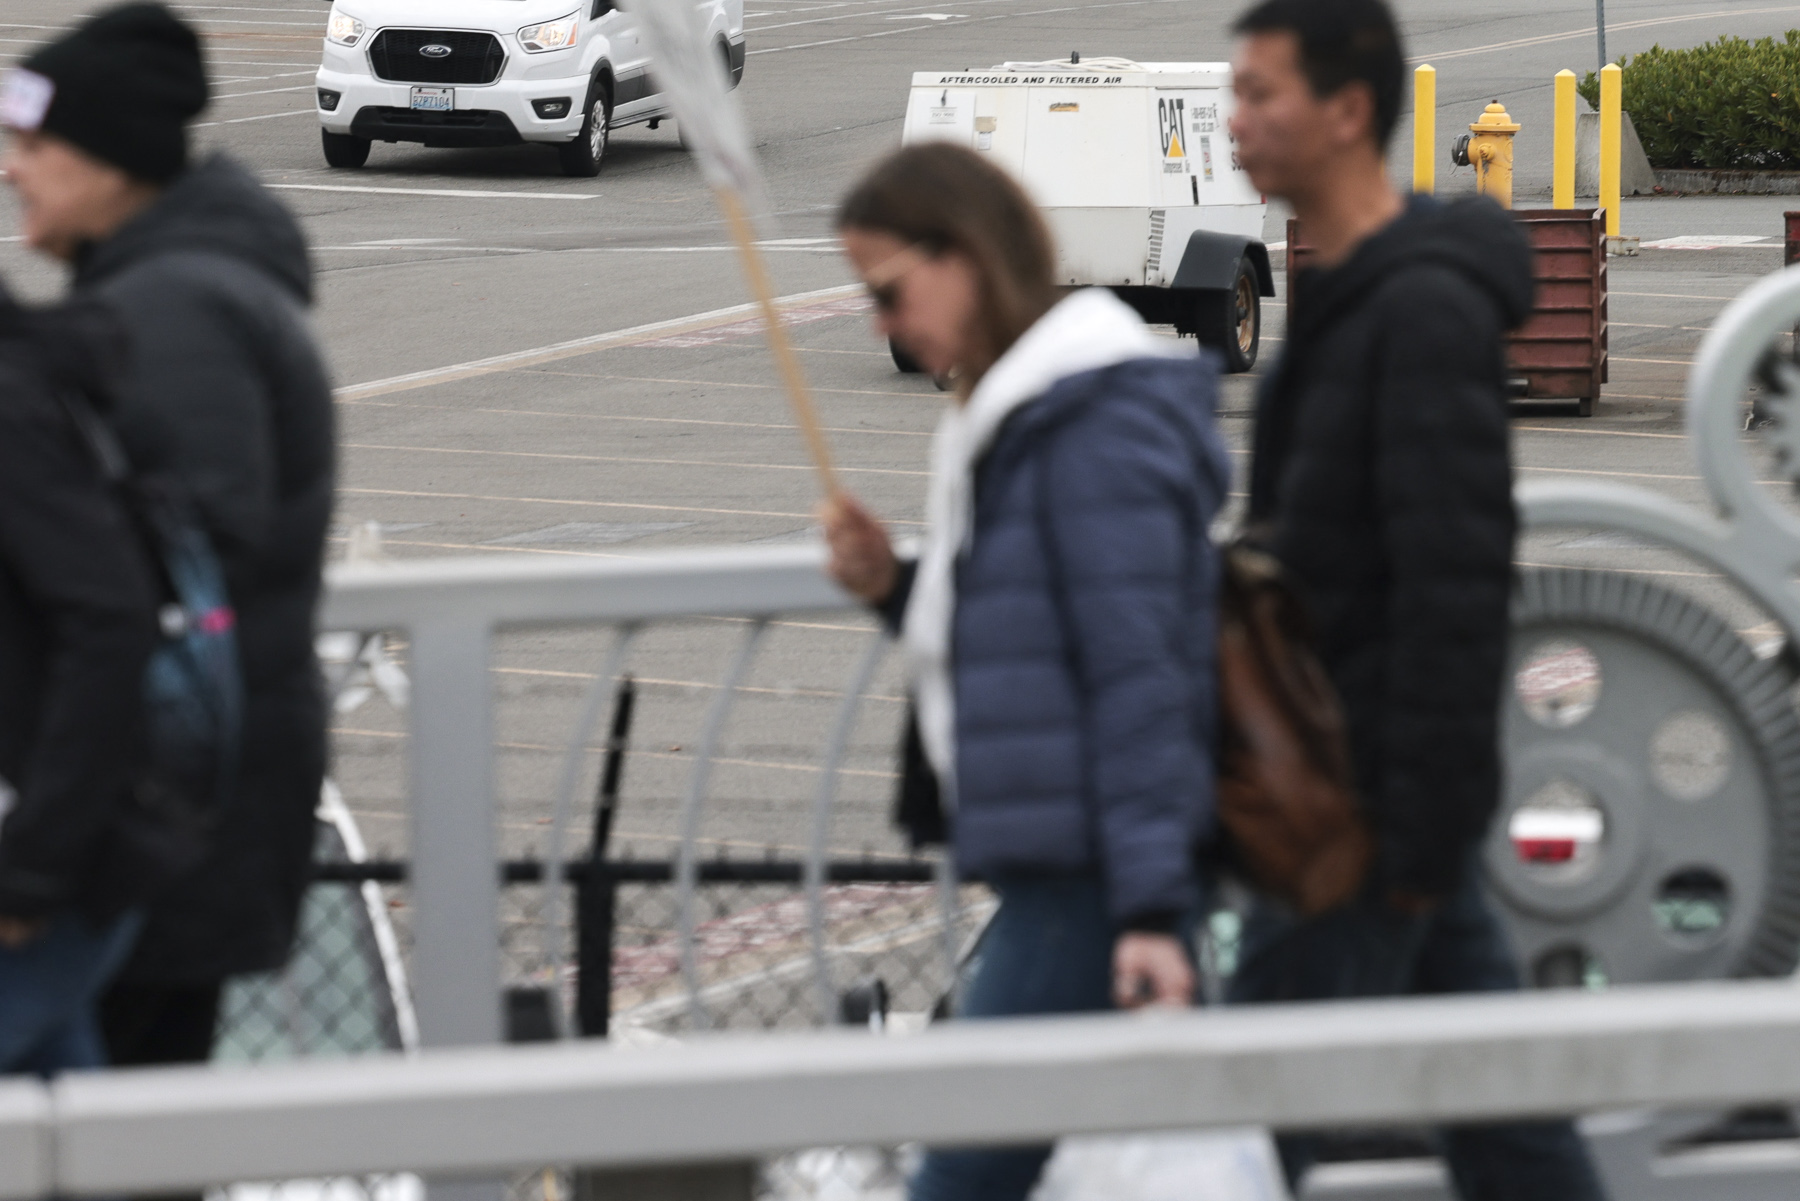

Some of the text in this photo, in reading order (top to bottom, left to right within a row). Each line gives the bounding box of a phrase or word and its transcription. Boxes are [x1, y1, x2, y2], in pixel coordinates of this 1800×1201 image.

[939, 76, 1122, 85] AFTERCOOLED AND FILTERED AIR
[1158, 97, 1187, 157] CAT
